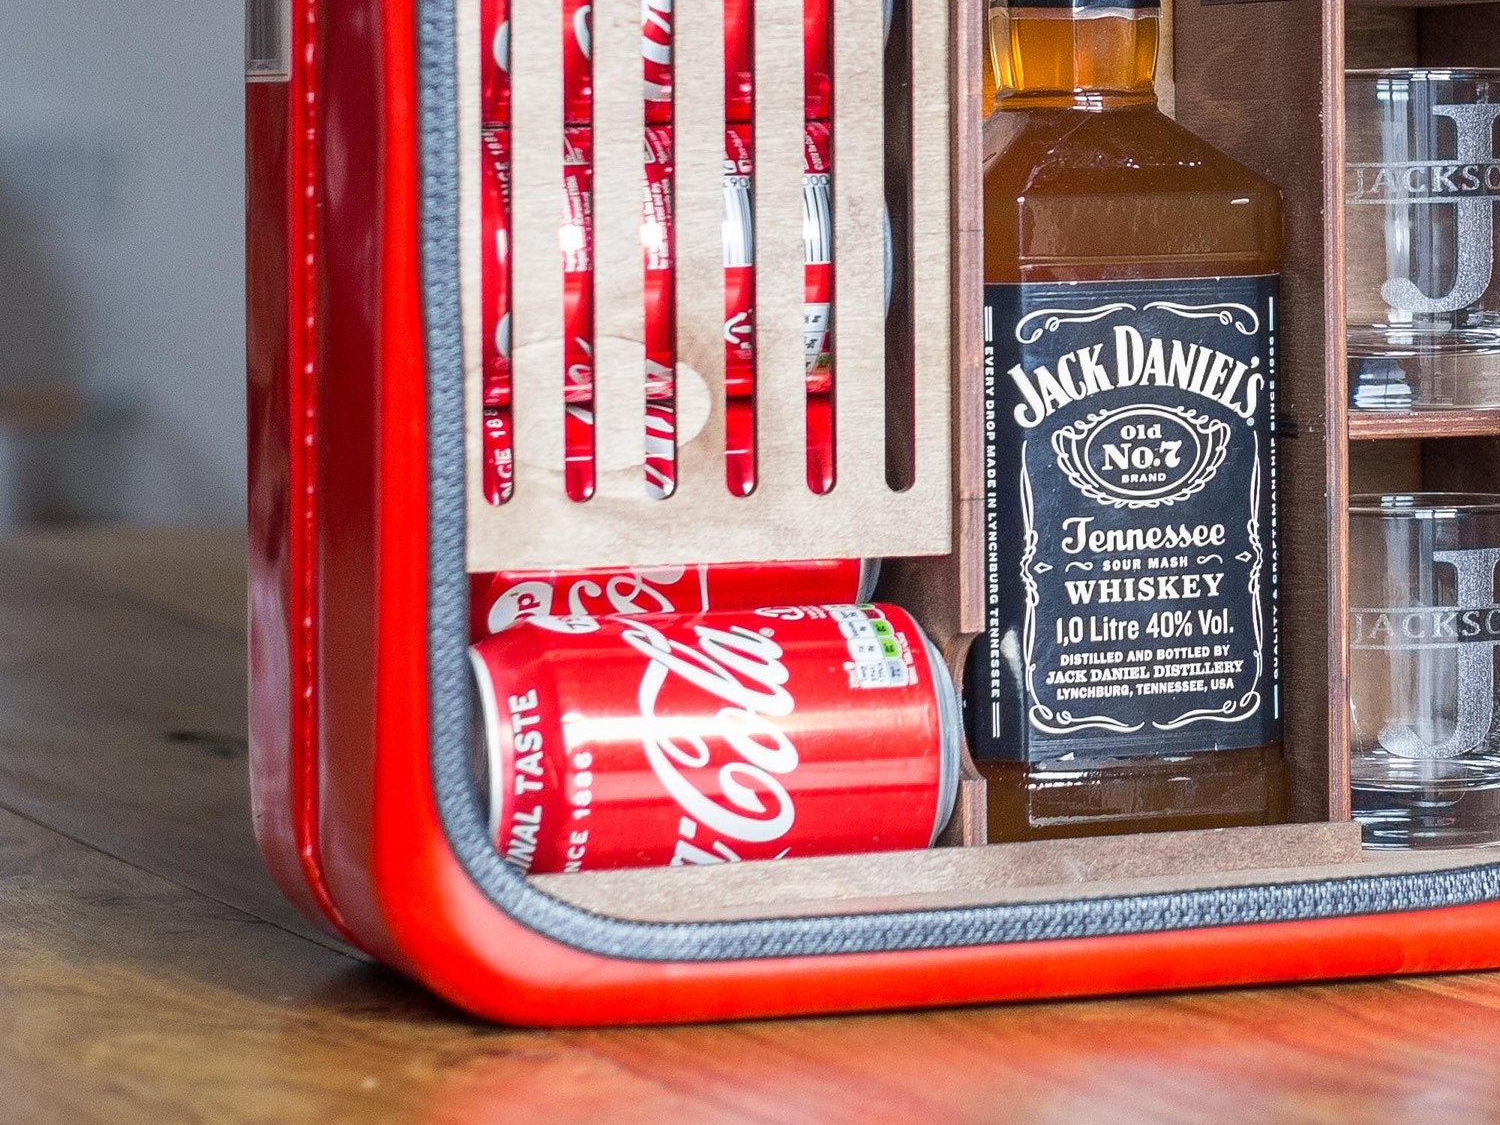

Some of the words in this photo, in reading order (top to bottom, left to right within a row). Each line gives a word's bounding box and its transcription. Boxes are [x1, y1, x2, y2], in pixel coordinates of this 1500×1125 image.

[984, 346, 994, 396] EVERY
[1007, 342, 1114, 428] JACK
[985, 400, 996, 441] DROP
[1120, 424, 1162, 440] Old
[986, 445, 997, 488] MADE
[1101, 440, 1182, 471] No.7
[1121, 473, 1167, 483] BRAND
[987, 492, 997, 508] IN
[1061, 516, 1226, 554] Tennessee
[988, 512, 999, 605] LYNCHBURG
[1102, 559, 1142, 572] SOUR
[1148, 556, 1188, 570] MASH
[1064, 573, 1225, 605] WHISKEY
[1056, 616, 1084, 647] 1,0
[1090, 615, 1140, 643] Litre
[1145, 610, 1193, 639] 40%
[1198, 608, 1234, 635] Vol.
[989, 607, 1000, 698] TENNESSEE
[1060, 651, 1123, 666] DISTILLED
[1126, 649, 1153, 662] AND
[1156, 646, 1211, 661] BOTTLED
[1213, 645, 1230, 656] BY
[1046, 669, 1088, 685] JACK
[1090, 666, 1150, 682] DANIEL
[1153, 660, 1244, 678] DISTILLERY
[1056, 684, 1134, 701] LYNCHBURG,
[1136, 680, 1208, 695] TENNESSEE,
[1210, 678, 1234, 690] USA
[508, 688, 544, 795] TASTE
[506, 805, 543, 873] INAL
[563, 830, 590, 874] NCE
